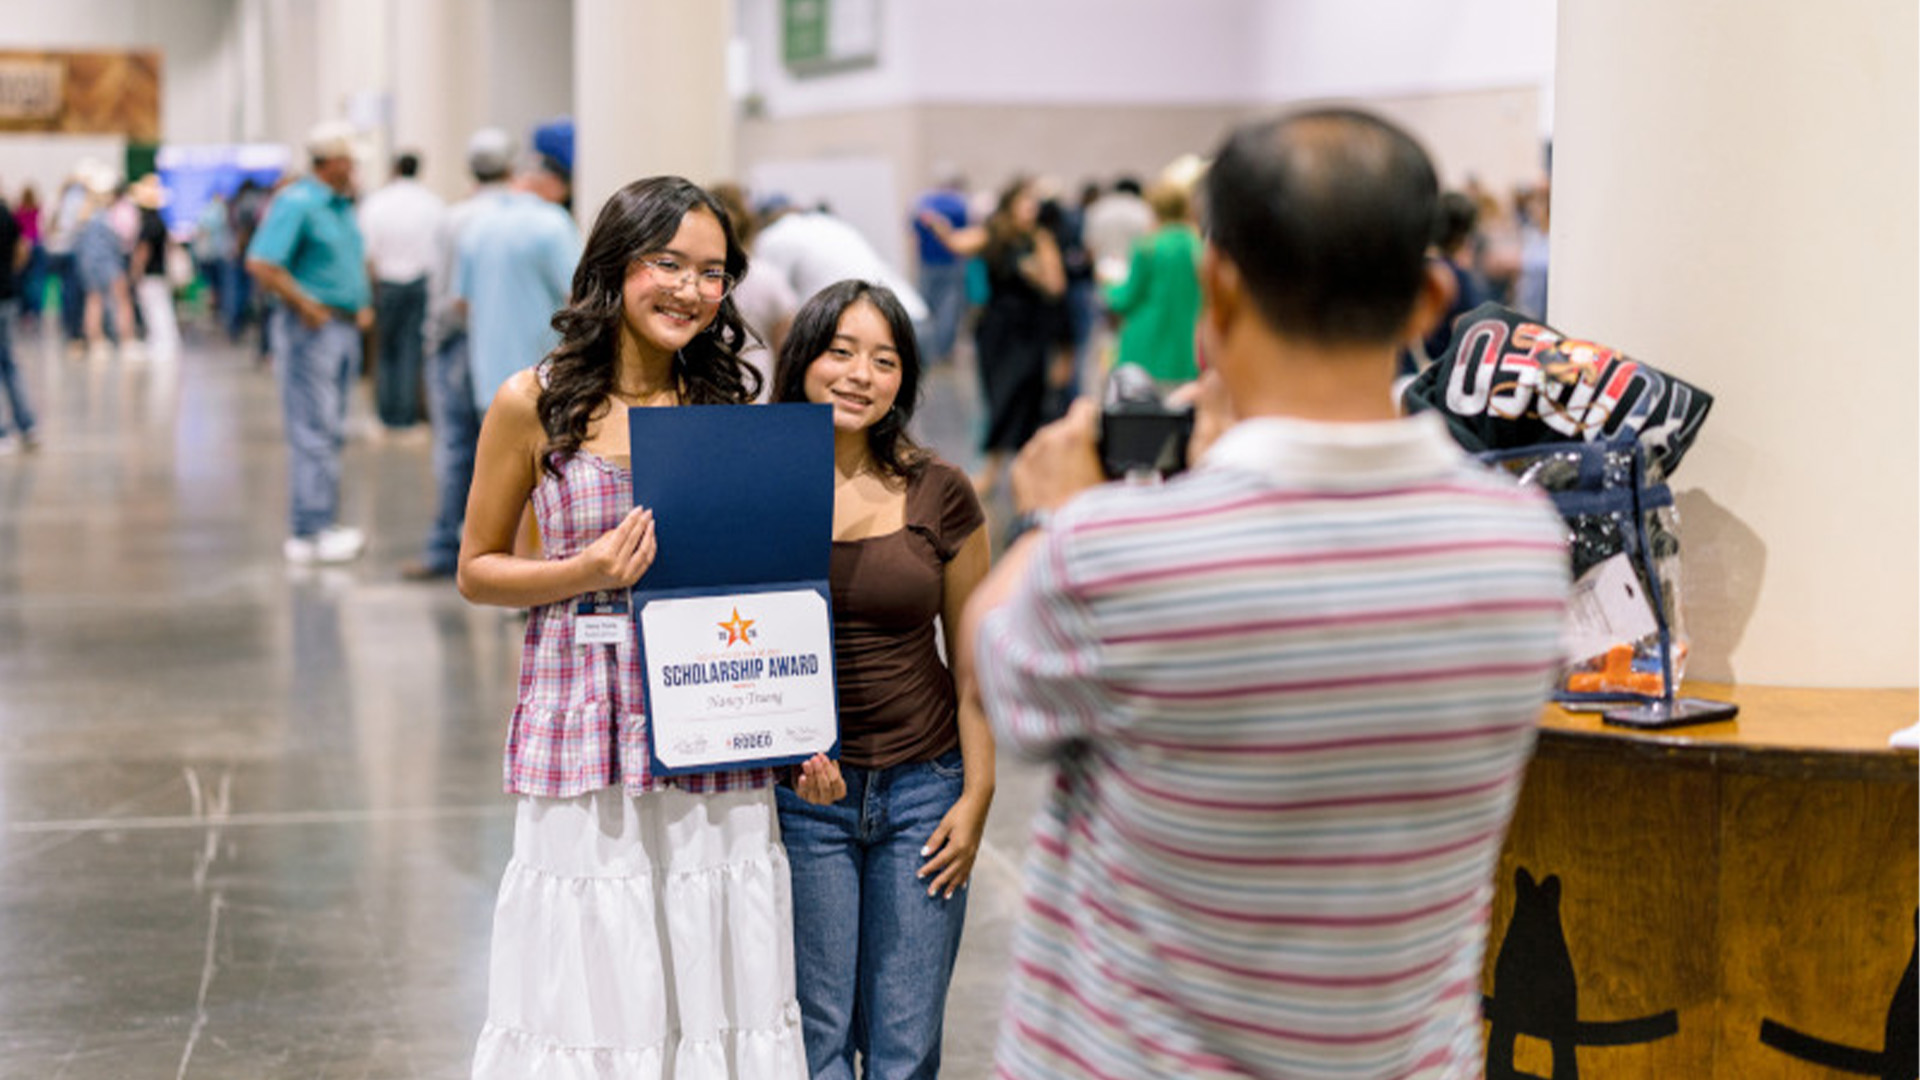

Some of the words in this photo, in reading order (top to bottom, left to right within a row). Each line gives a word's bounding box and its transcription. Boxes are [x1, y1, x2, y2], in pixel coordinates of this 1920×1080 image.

[662, 658, 764, 687] SCHOLARSHIP
[769, 653, 819, 678] AWARD
[733, 734, 773, 749] RODEO
